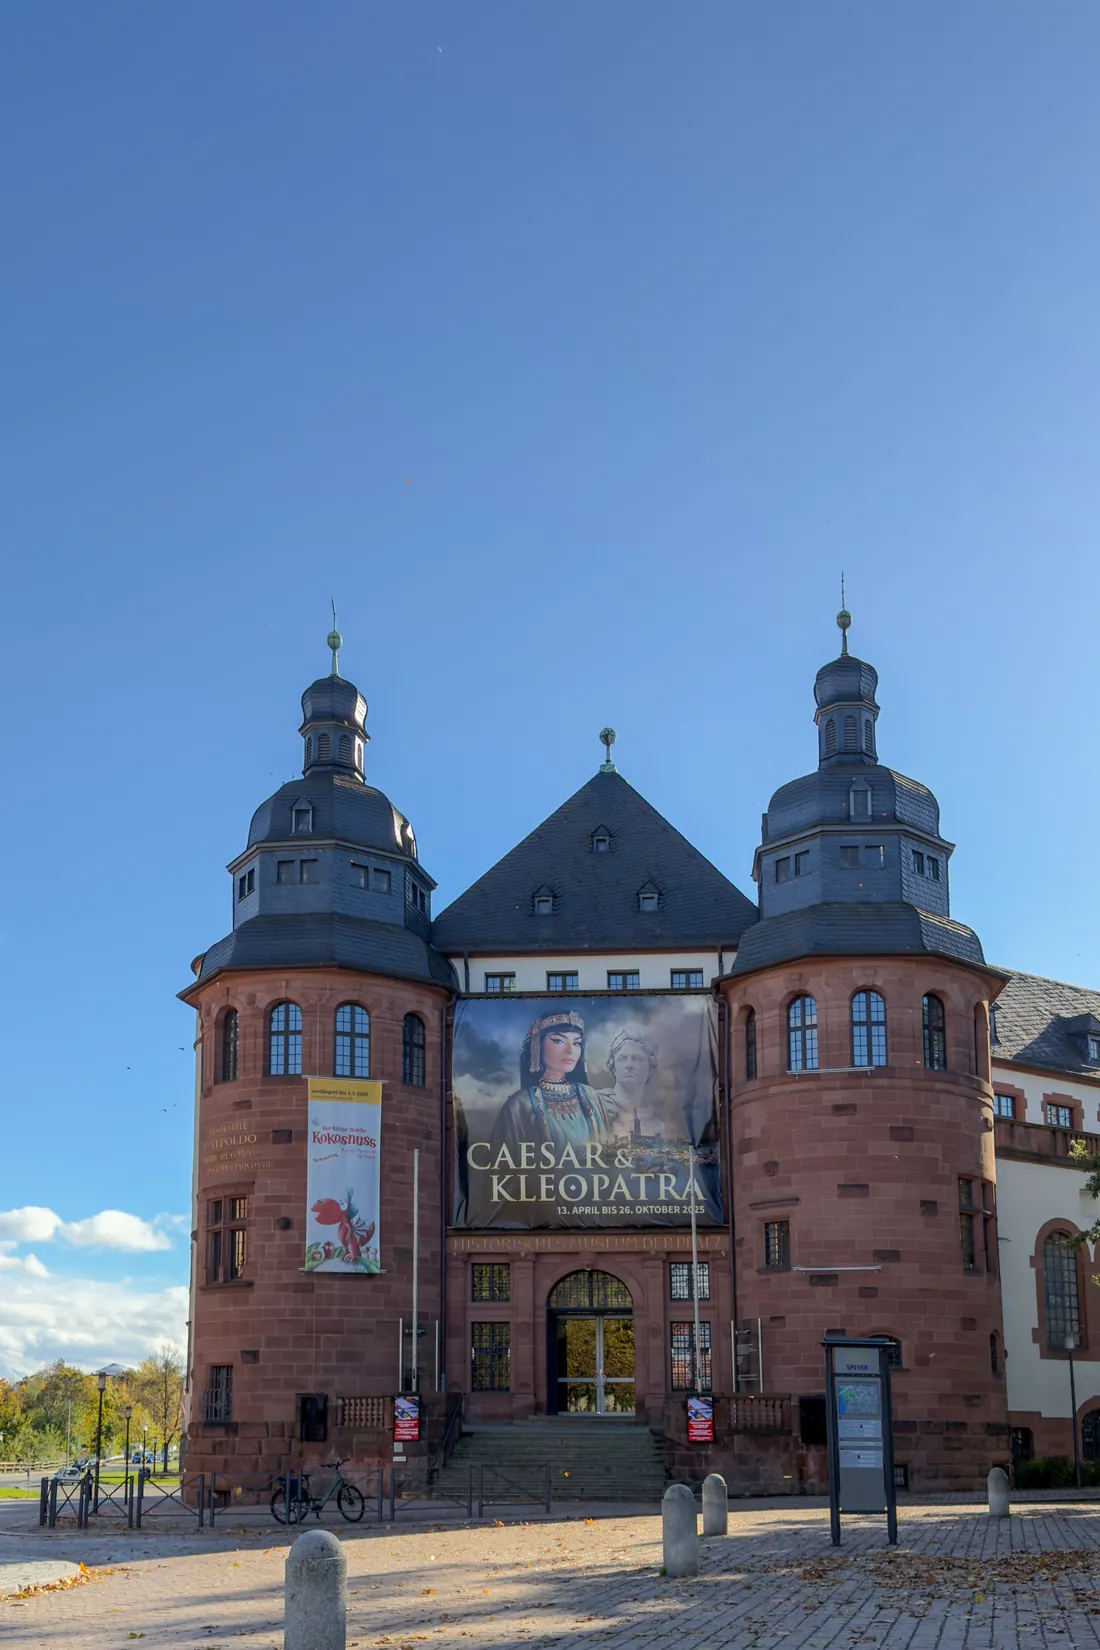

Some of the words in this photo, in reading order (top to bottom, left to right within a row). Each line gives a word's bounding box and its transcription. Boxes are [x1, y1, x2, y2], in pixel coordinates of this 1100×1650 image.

[466, 1141, 611, 1170] CAESAR
[614, 1148, 636, 1169] &
[489, 1173, 708, 1202] KLEOPATRA
[557, 1206, 571, 1215] 13.
[572, 1206, 600, 1215] APRIL
[601, 1206, 617, 1215] BIS
[619, 1206, 634, 1214] 26.
[635, 1205, 680, 1214] OKTOBER
[682, 1205, 706, 1214] 2025
[643, 1236, 673, 1249] DER
